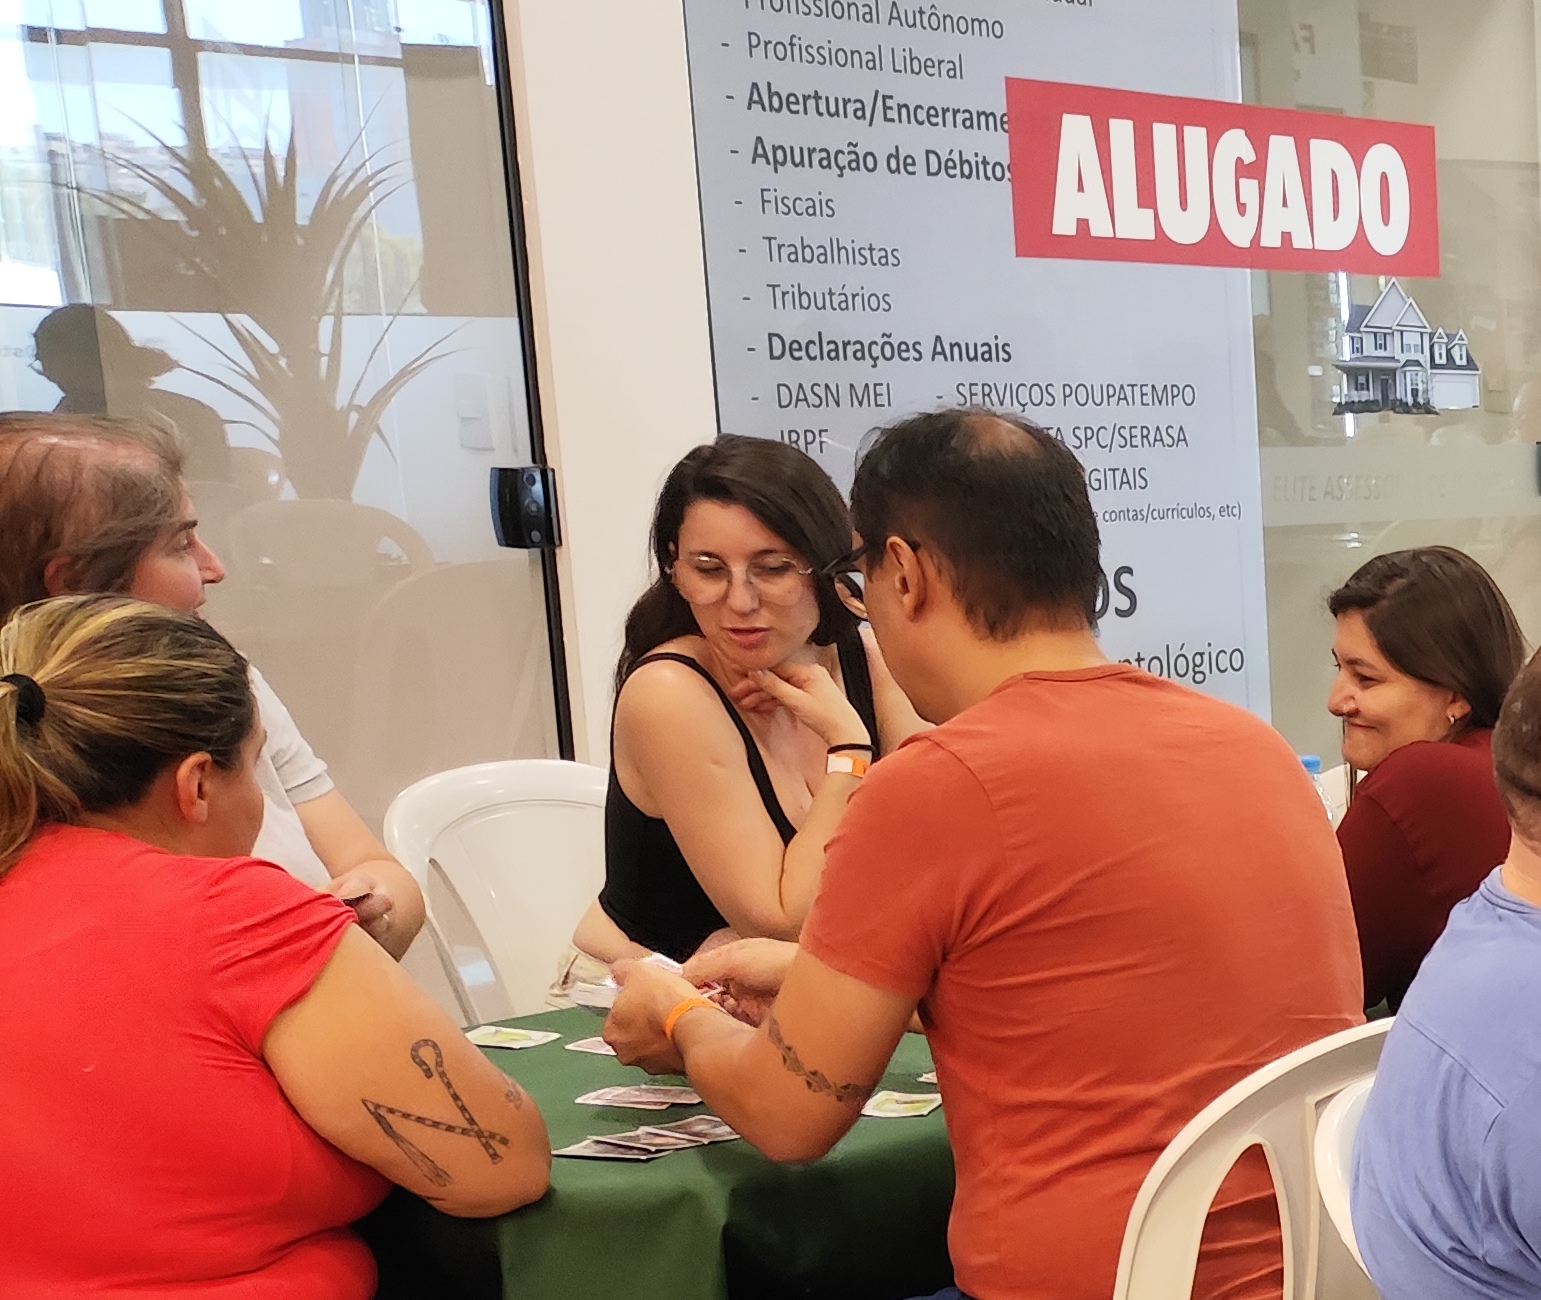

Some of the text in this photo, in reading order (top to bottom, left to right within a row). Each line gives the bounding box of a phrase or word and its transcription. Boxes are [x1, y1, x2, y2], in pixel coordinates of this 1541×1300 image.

[887, 1, 1004, 40] Autônomo
[746, 32, 964, 80] Profissional Liberal
[751, 136, 1012, 183] Apuração de Débito
[1052, 112, 1411, 257] ALUGADO
[760, 188, 836, 219] Fiscais
[762, 236, 902, 269] Trabalhistas
[766, 283, 892, 313] Tributários
[768, 333, 1012, 365] Declarações Anuais
[776, 382, 1196, 412] DASN MEI SERVIÇOS POUPATEMPO
[1072, 423, 1189, 453] SPC/SERASA
[1088, 467, 1149, 491] GITAIS
[1102, 502, 1216, 524] contas/currículos,
[1218, 501, 1242, 521] etc)
